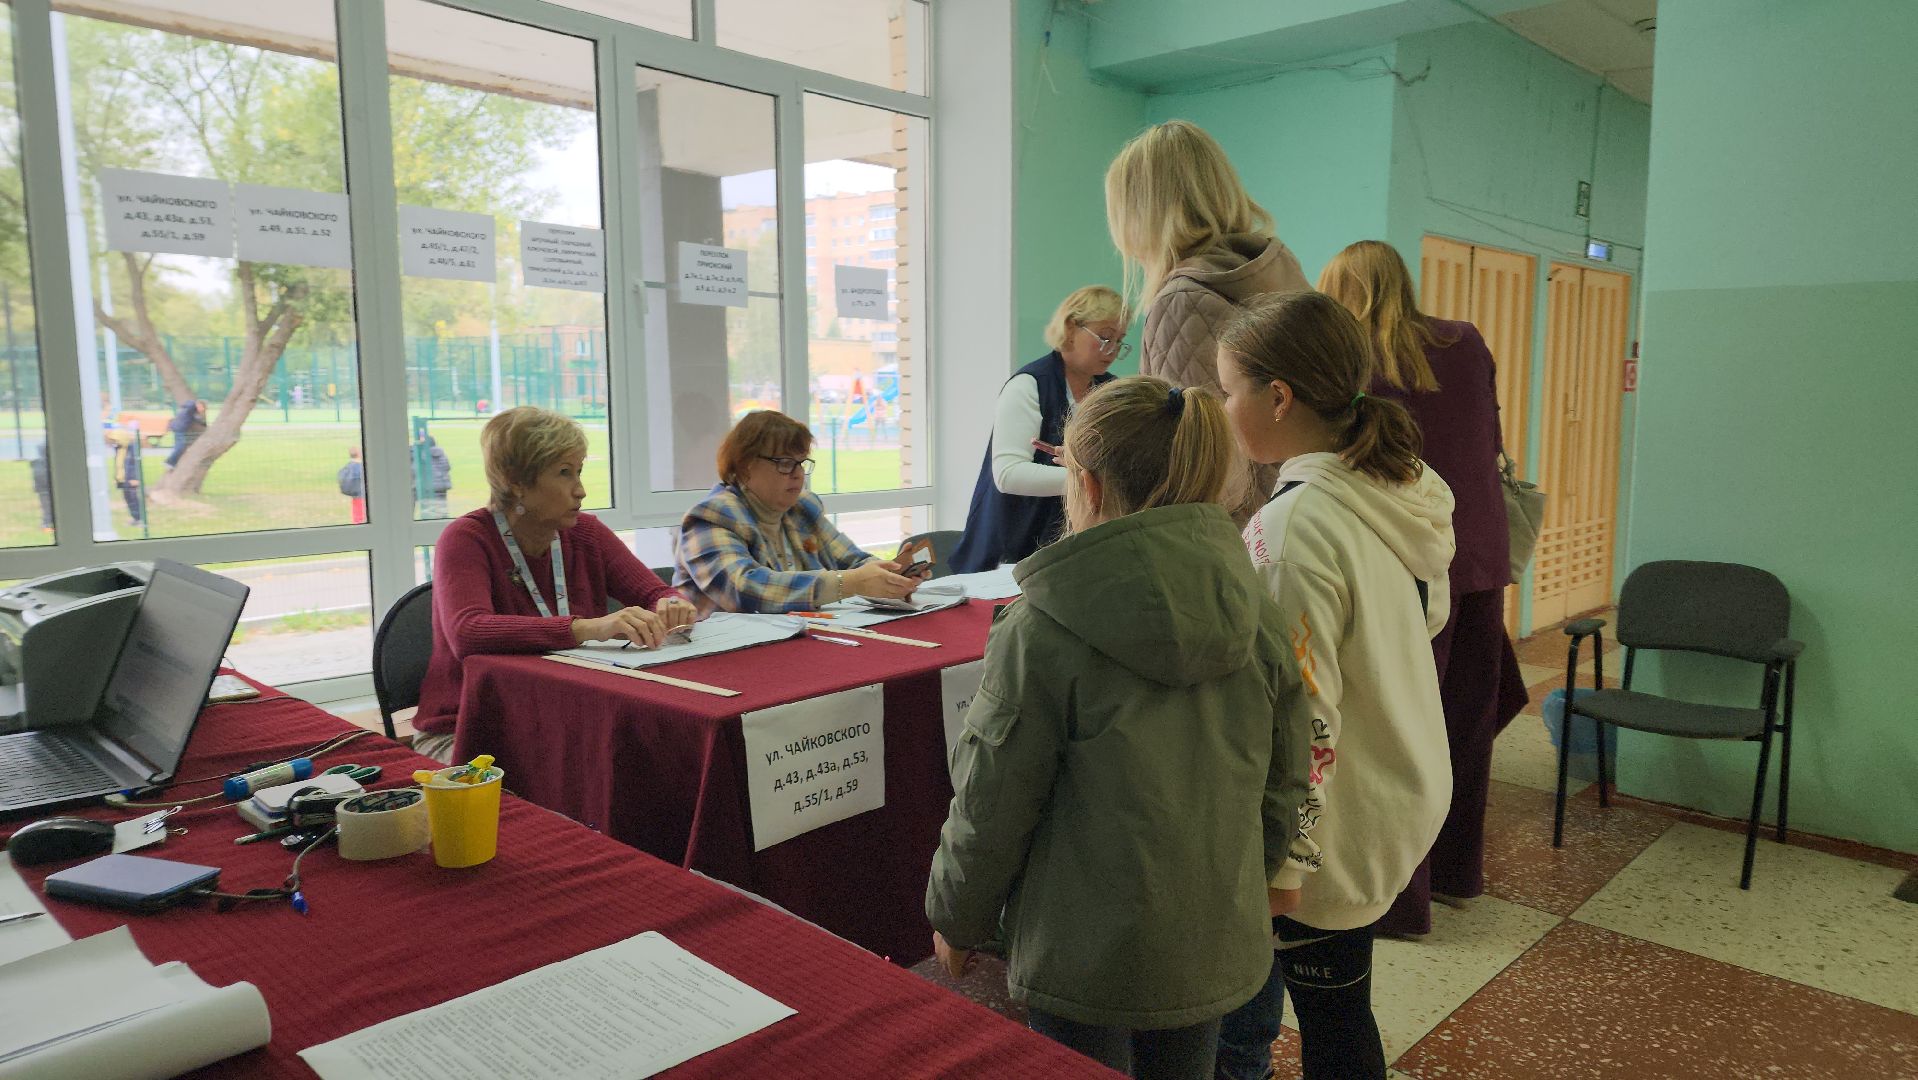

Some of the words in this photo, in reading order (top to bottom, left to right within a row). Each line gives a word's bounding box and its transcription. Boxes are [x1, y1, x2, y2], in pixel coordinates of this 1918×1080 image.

[136, 194, 217, 209] ЧАЙКОВСКОГО
[265, 208, 338, 222] ЧАЙКОВСКОГО
[956, 700, 970, 712] ул.
[765, 749, 783, 765] ул.
[785, 722, 871, 756] ЧАЙКОВСКОГО
[773, 771, 803, 793] д.43,
[806, 762, 840, 781] д.43а,
[842, 750, 869, 770] д.53,
[793, 790, 833, 815] д.55/1,
[836, 778, 859, 799] д.59
[1293, 963, 1333, 979] NIKE
